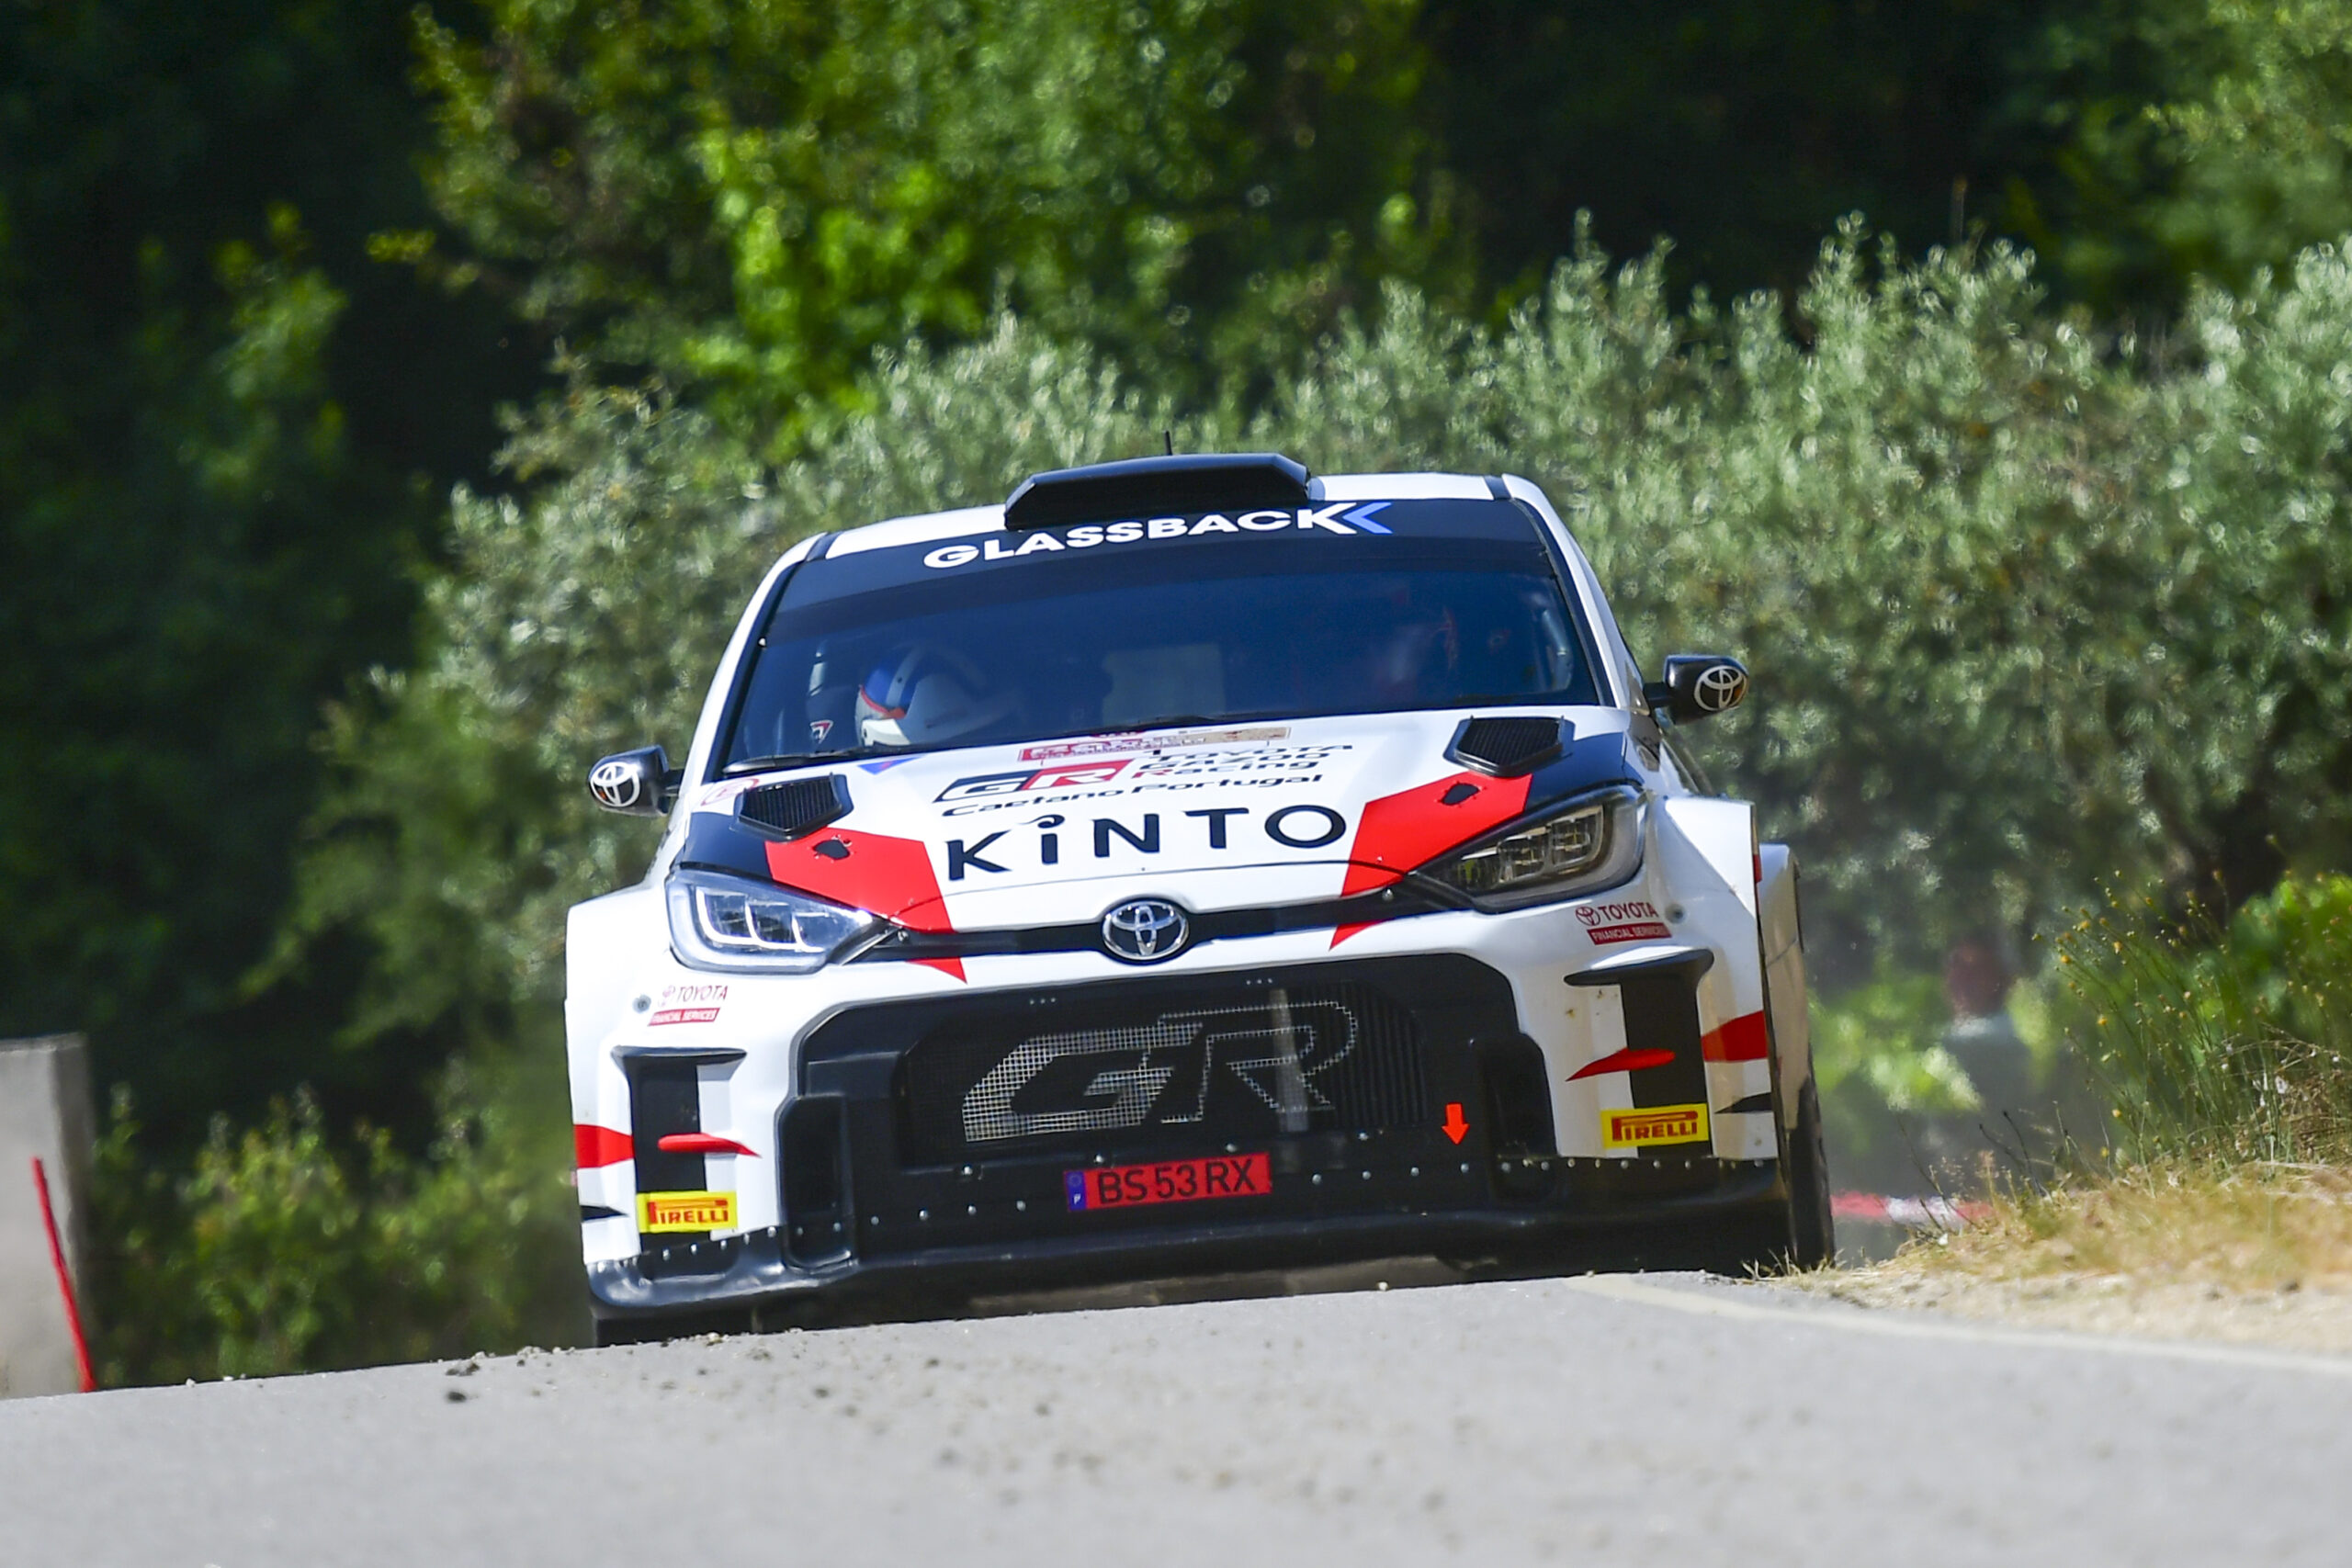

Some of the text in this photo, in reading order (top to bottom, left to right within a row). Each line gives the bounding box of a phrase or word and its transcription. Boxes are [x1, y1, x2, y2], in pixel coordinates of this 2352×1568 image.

[923, 502, 1358, 569] GLASSBACK
[1139, 752, 1330, 770] GAZOO
[1148, 744, 1353, 761] TOYOTA
[933, 759, 1134, 804] GR
[942, 774, 1323, 817] Caetano Portugal
[1597, 902, 1659, 921] TOYOTA
[677, 985, 729, 1003] TOYOTA
[962, 1000, 1358, 1142] GR
[1611, 1110, 1699, 1142] PIRELLI
[1098, 1158, 1256, 1204] BS 53 RX
[647, 1199, 729, 1224] PIRELLI
